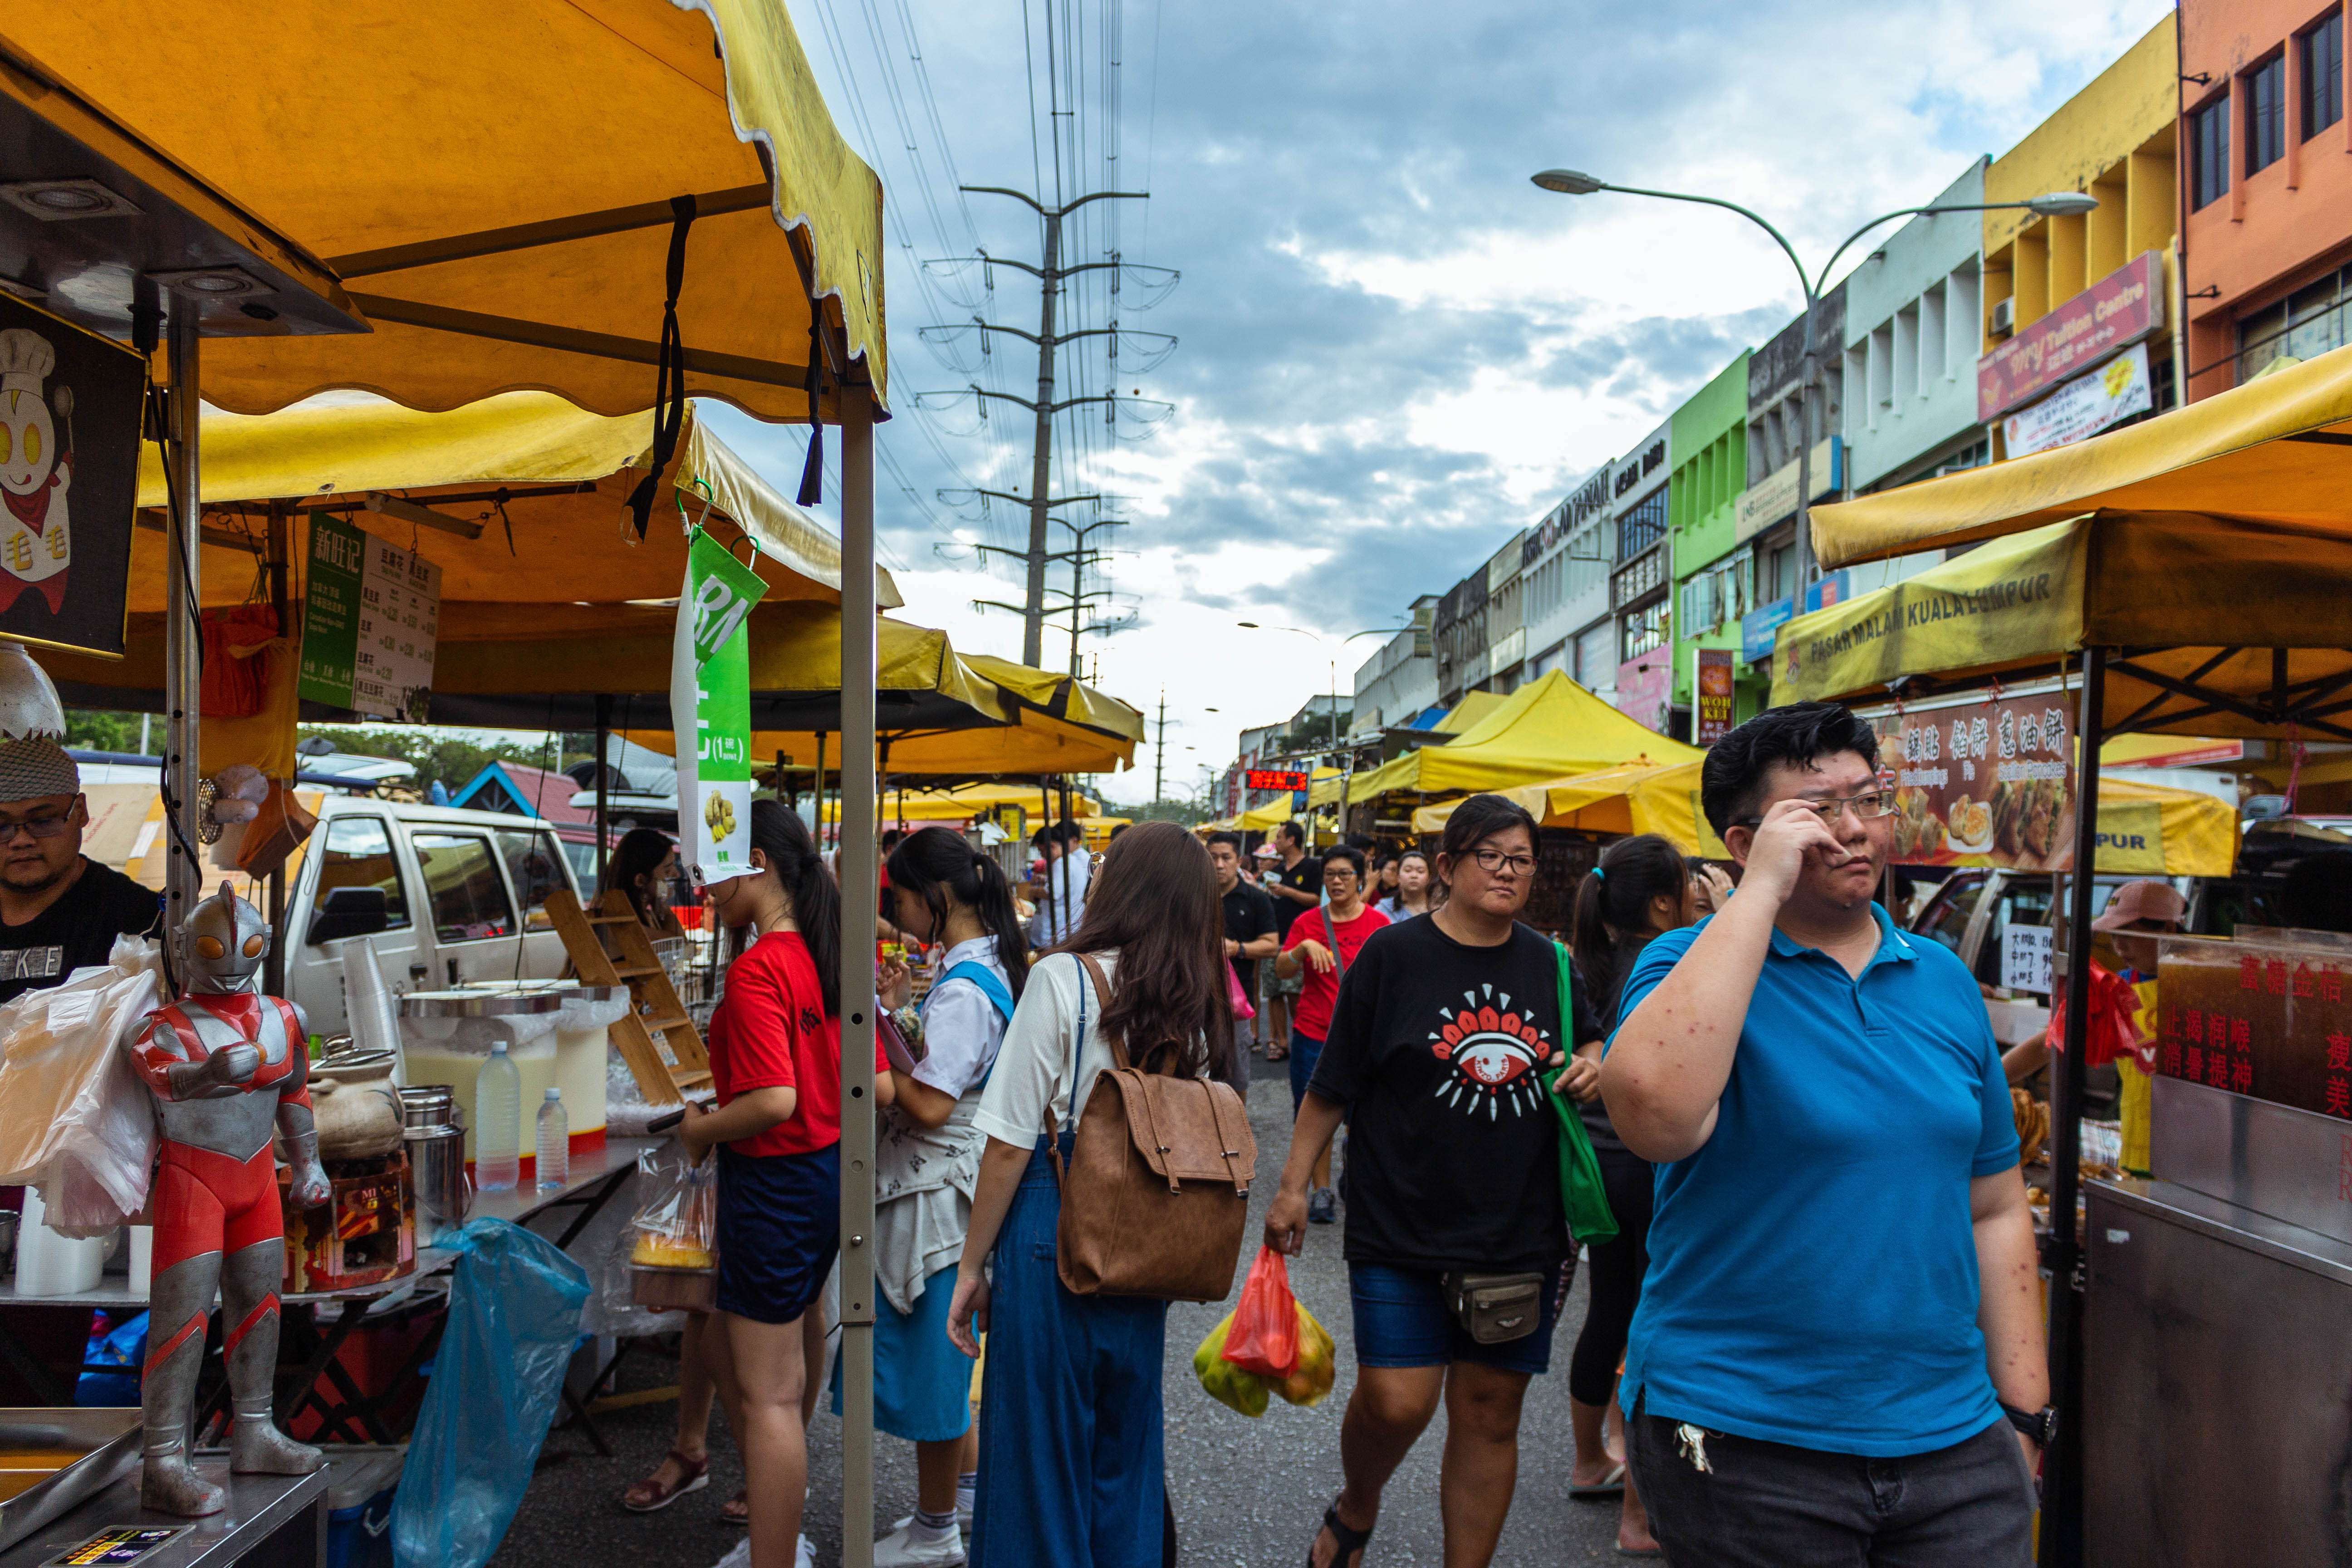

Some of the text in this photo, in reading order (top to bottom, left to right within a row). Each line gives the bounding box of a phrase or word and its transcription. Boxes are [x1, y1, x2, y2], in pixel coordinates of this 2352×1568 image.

[2045, 315, 2092, 350] Tuition
[2095, 282, 2144, 322] Centre
[6, 524, 67, 571] 毛毛
[315, 525, 360, 573] 新旺记
[1811, 573, 2051, 662] PASAR MALAM KUALA LUMPUR
[2096, 833, 2146, 850] PUR
[2011, 948, 2019, 967] 中
[2239, 954, 2343, 1004] 蜜糖金桔
